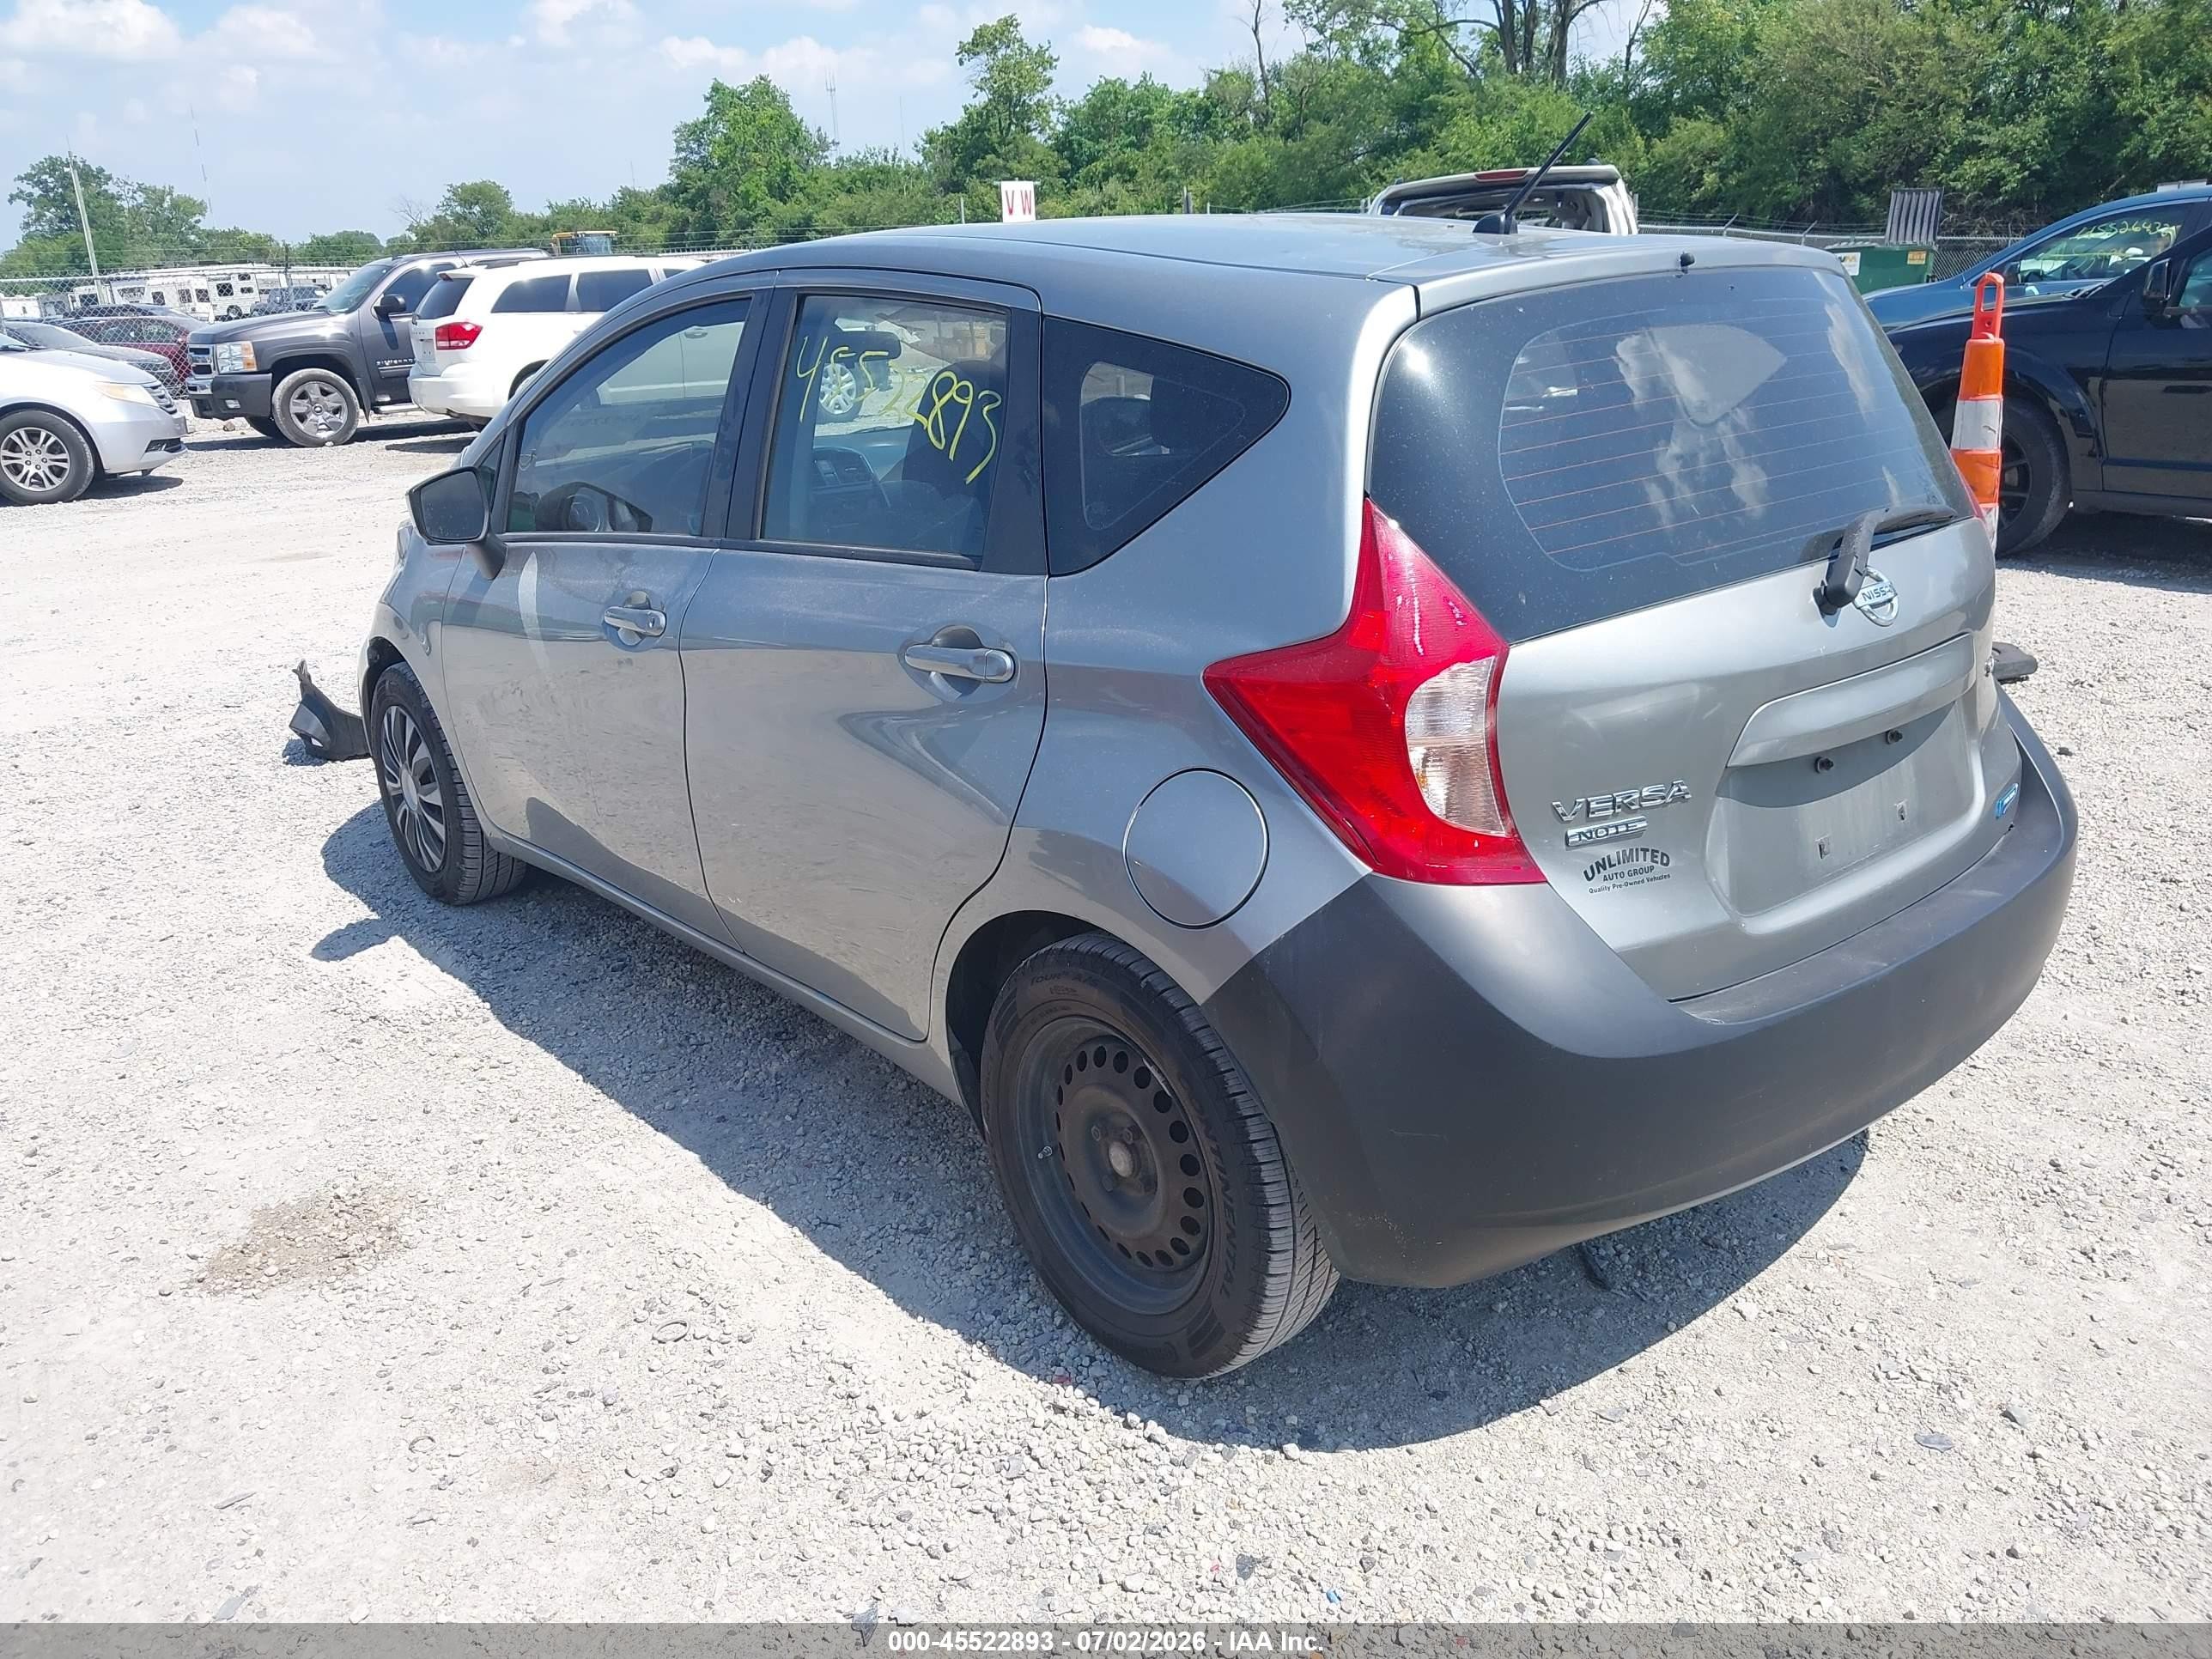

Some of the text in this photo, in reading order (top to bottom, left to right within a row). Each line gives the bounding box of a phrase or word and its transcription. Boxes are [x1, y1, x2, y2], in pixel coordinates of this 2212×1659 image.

[1552, 779, 1692, 822] VERSA
[1577, 823, 1640, 842] NOTE
[1583, 847, 1671, 882] UNLIMITED
[1602, 865, 1656, 882] AUTO GROUP
[1589, 872, 1671, 894] Quality Pre-Owned Vehicles
